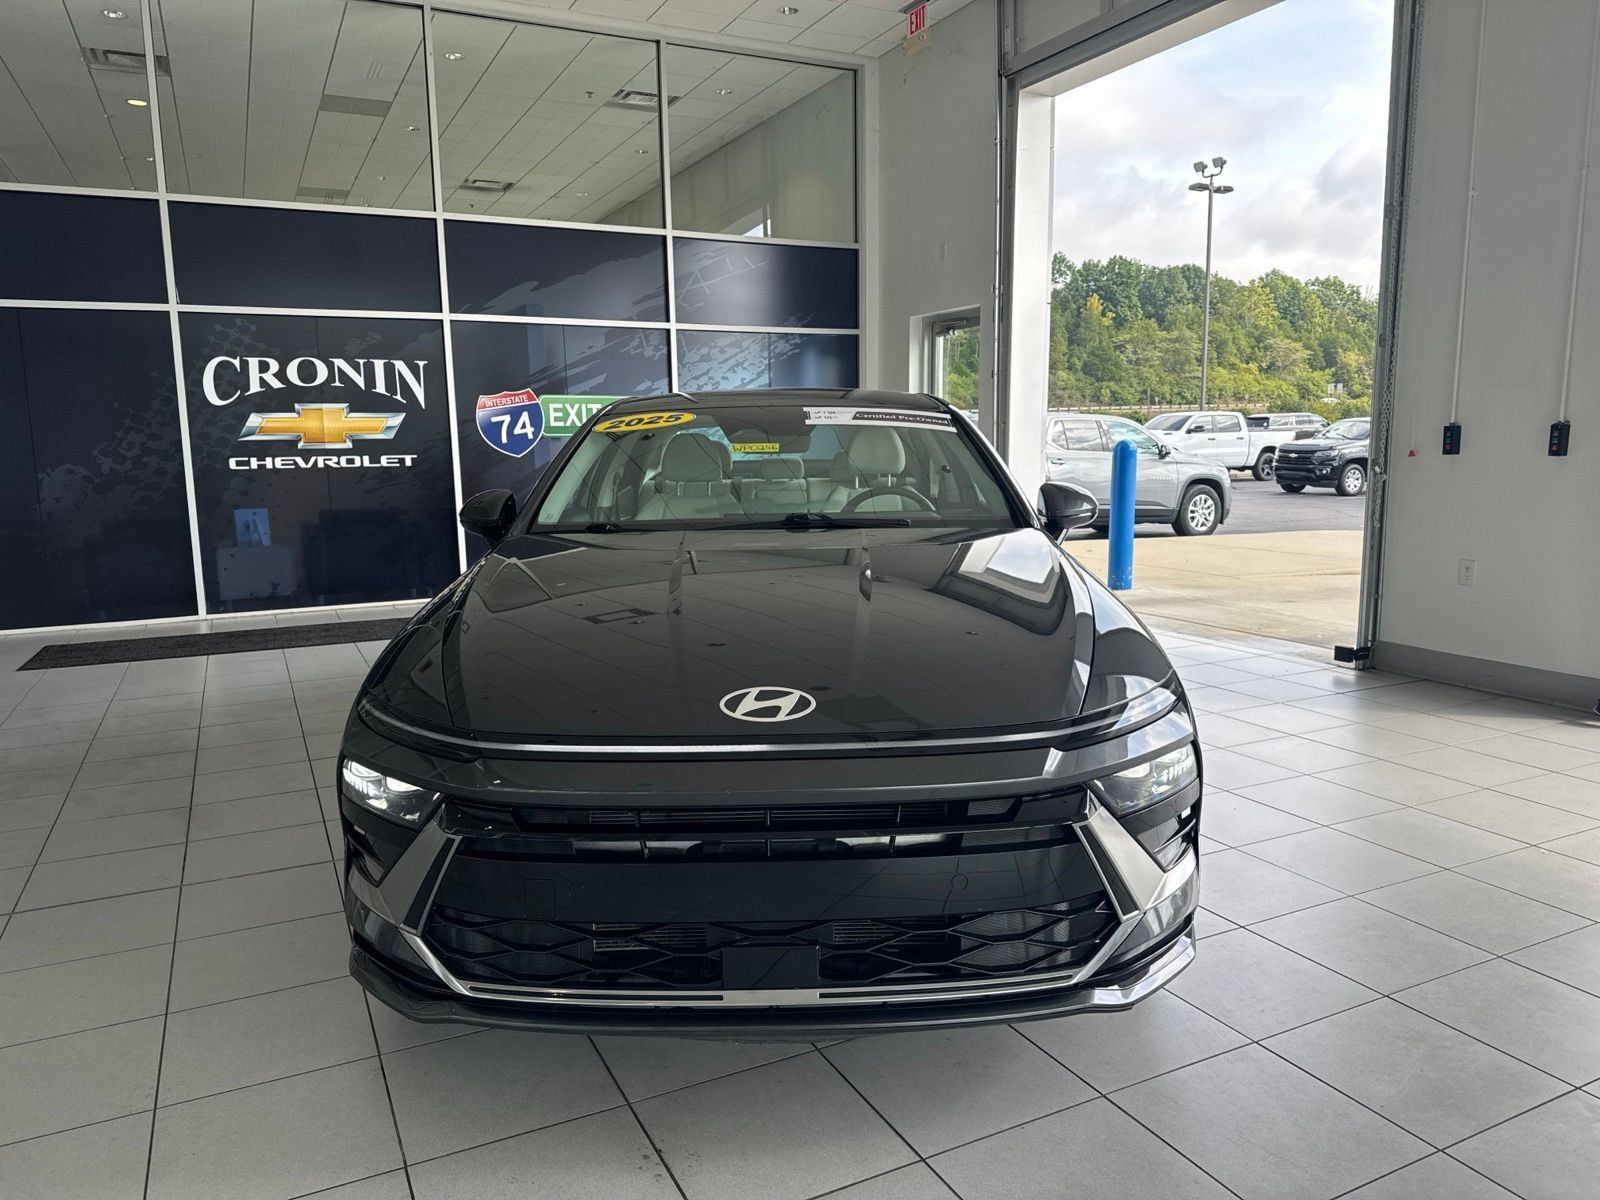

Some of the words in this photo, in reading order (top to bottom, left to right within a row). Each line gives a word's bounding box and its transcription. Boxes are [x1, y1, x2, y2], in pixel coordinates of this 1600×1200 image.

[909, 4, 926, 36] EXIT
[202, 355, 429, 410] CRONIN
[484, 394, 530, 408] INTERSTATE
[490, 411, 535, 444] 74
[608, 413, 685, 430] 2025
[898, 415, 949, 425] Pre-Owned
[228, 454, 418, 470] CHEVROLET
